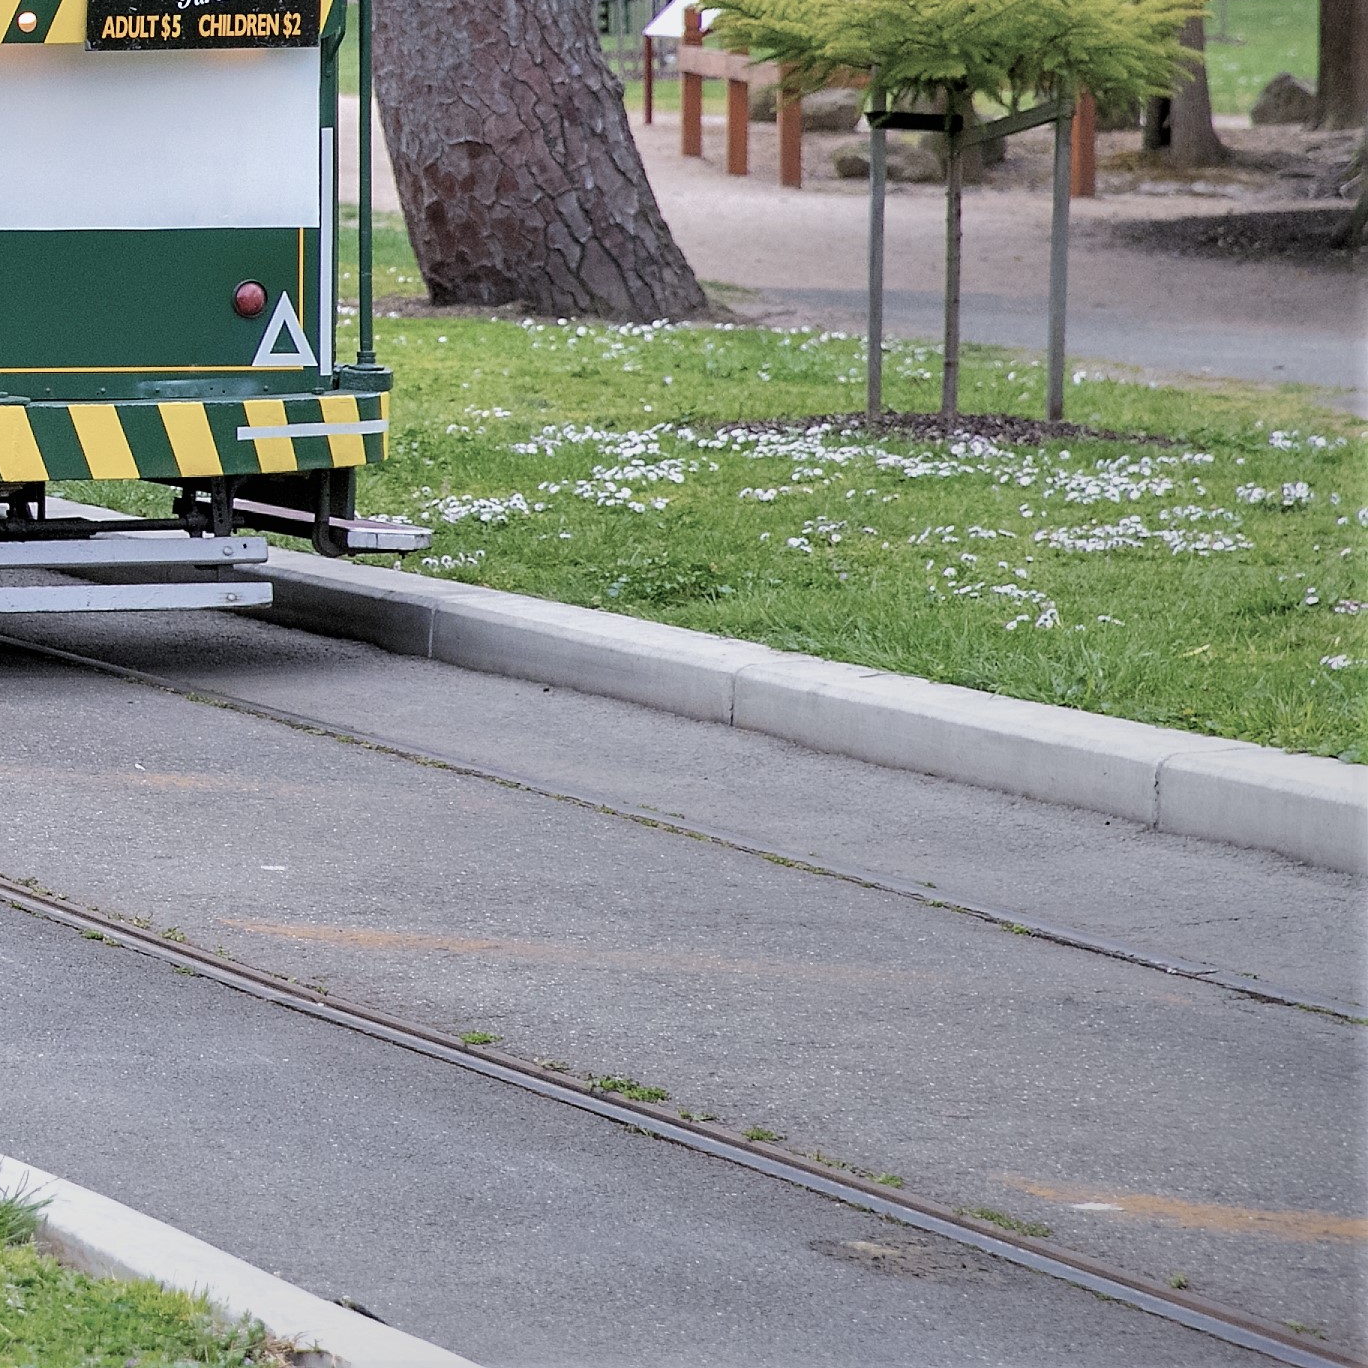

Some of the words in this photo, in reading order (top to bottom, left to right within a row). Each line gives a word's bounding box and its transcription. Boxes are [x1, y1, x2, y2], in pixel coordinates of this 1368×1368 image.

[101, 14, 160, 39] ADULT
[161, 13, 182, 41] $5
[198, 13, 280, 37] CHILDREN
[282, 11, 302, 39] $2
